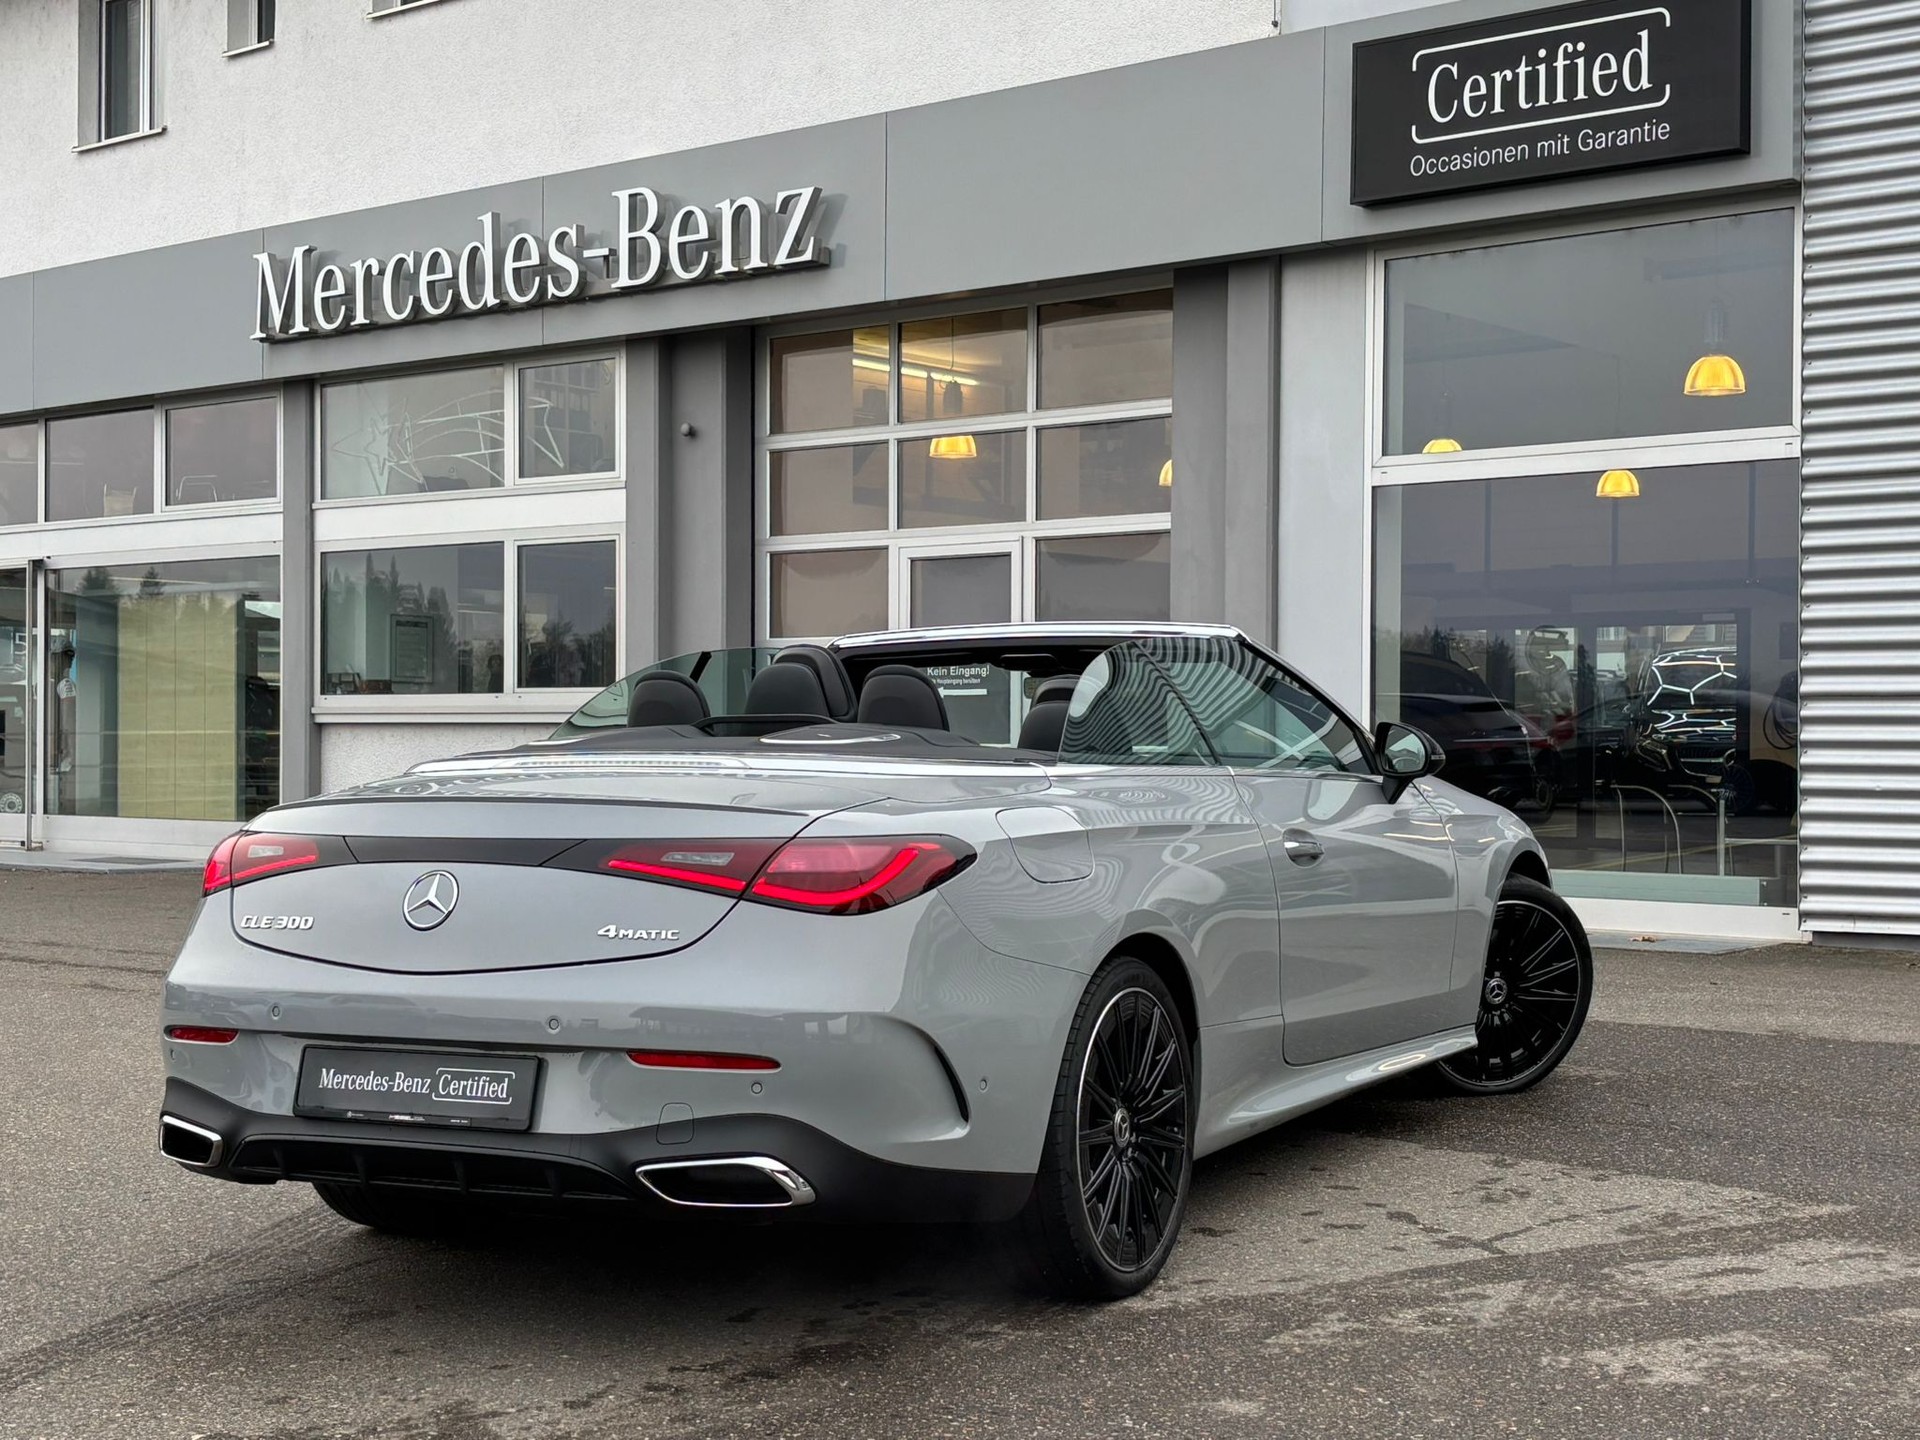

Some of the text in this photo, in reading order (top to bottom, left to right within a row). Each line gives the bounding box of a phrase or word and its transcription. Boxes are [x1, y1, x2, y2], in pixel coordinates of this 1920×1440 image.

[1427, 28, 1653, 125] Certified
[1410, 118, 1671, 177] Occasionen mit Garantie
[250, 186, 826, 342] Mercedes-Benz
[927, 665, 990, 678] Kein Eingang!
[240, 915, 315, 931] CLE 300
[597, 924, 680, 941] 4MATIC
[318, 1068, 509, 1098] Mercedes-Benz Certified
